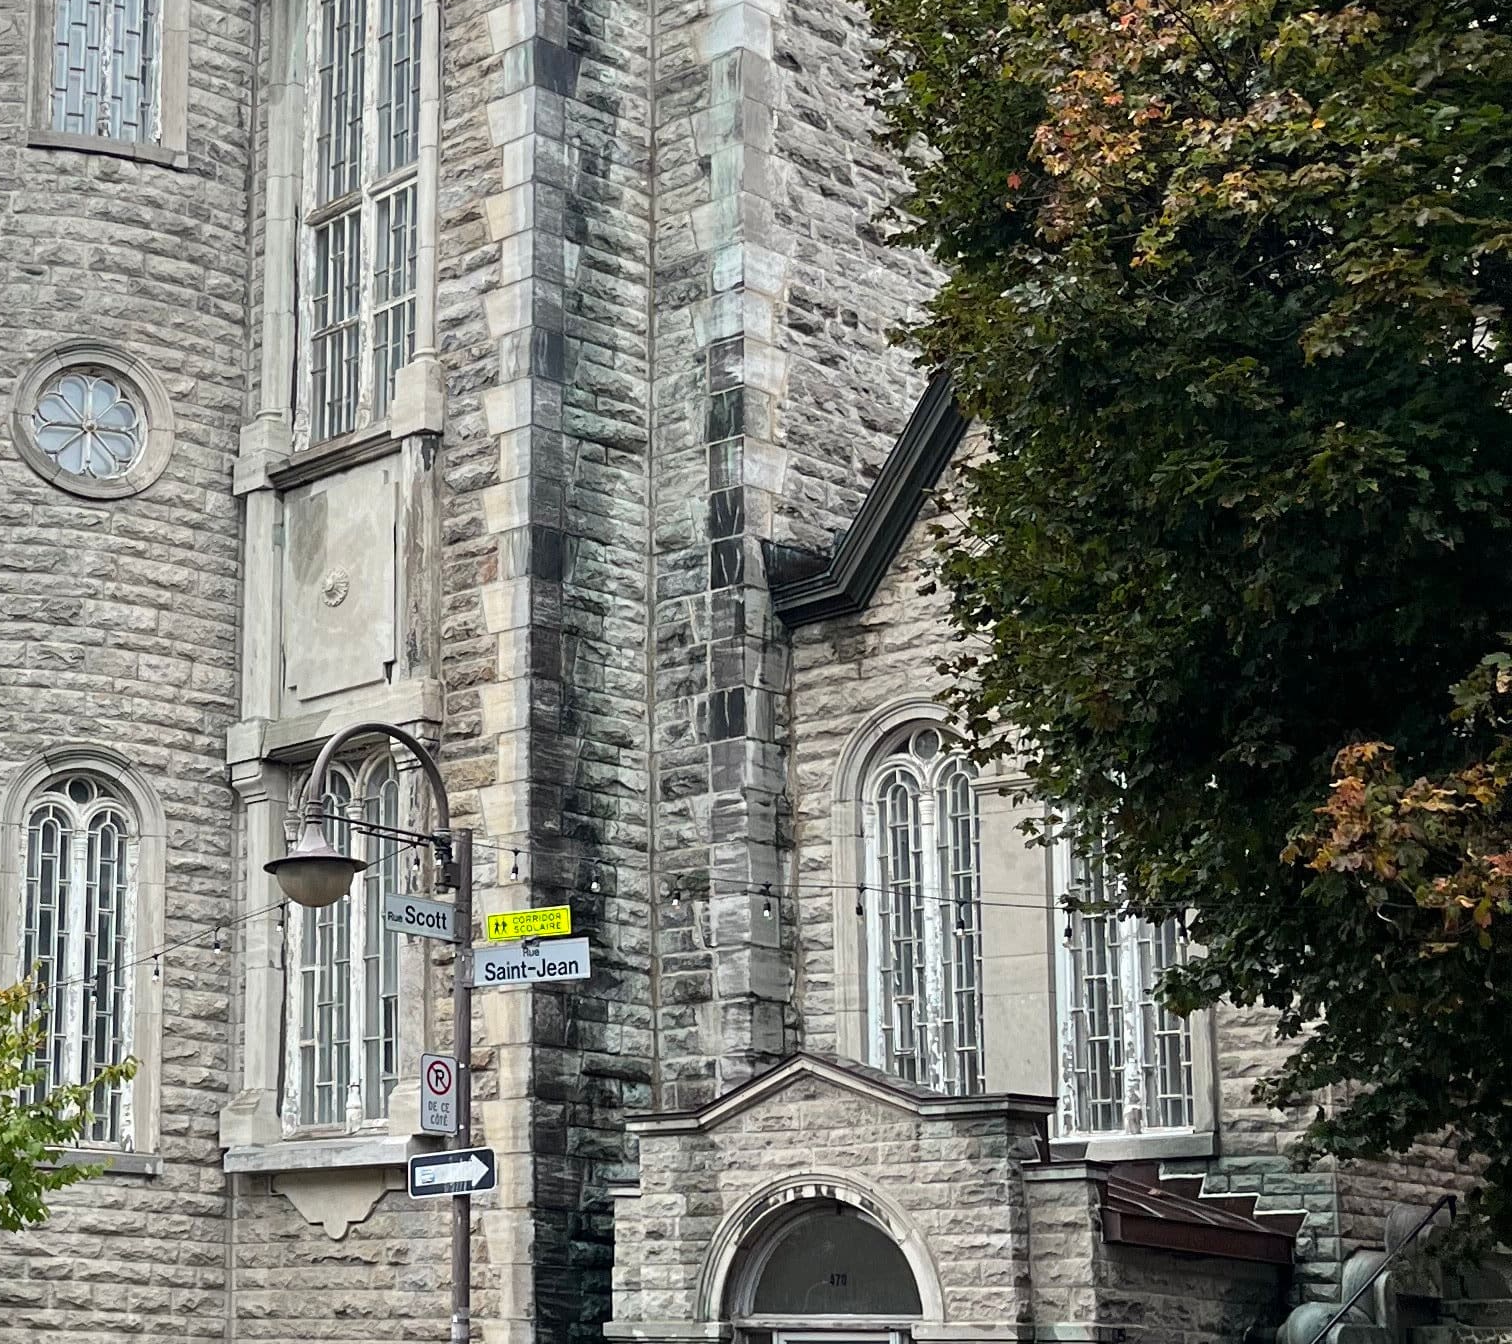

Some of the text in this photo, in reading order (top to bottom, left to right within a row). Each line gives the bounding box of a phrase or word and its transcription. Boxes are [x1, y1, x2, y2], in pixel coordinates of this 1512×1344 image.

[387, 905, 447, 930] Rue Scott
[512, 912, 561, 924] CORRIDOR
[513, 922, 561, 933] SCOLAIRE
[522, 947, 540, 957] Rue
[484, 958, 579, 981] Saint-Jean
[428, 1100, 450, 1113] DE CE
